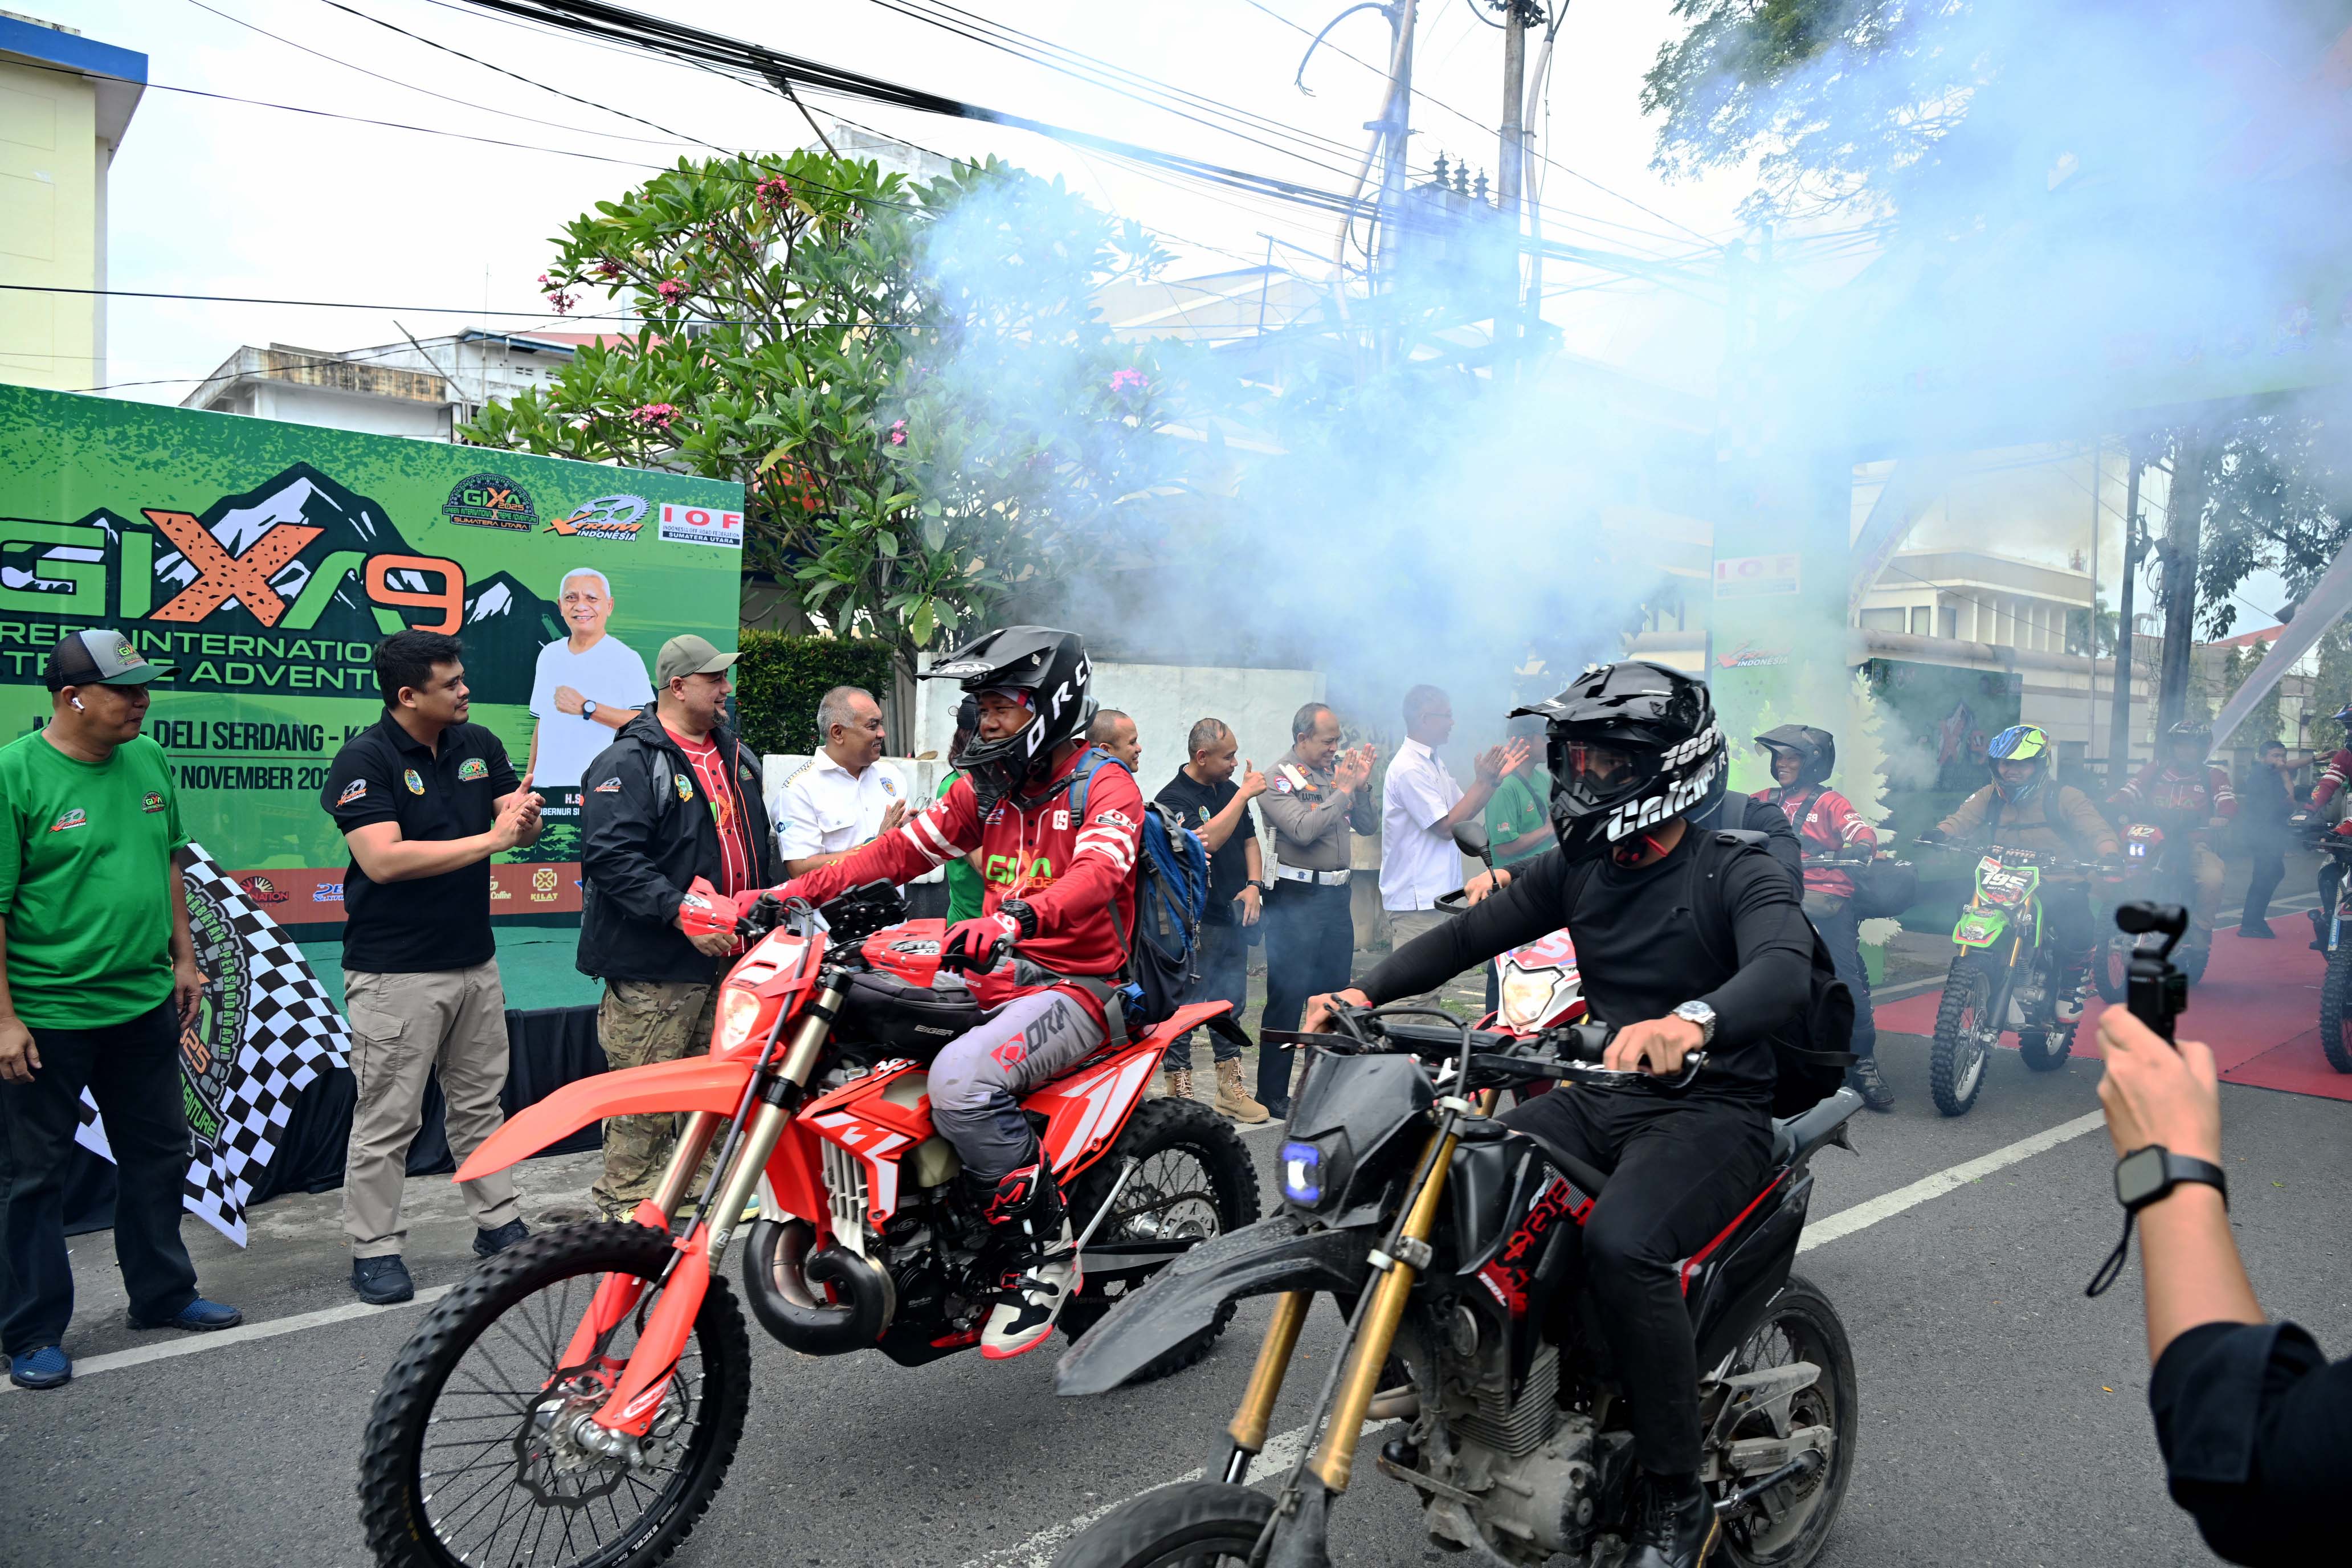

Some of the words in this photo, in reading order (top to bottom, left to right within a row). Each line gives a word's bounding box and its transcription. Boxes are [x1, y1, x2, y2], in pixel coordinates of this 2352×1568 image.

[463, 488, 521, 507] GIXA
[498, 502, 524, 511] 2025
[454, 517, 498, 526] SUMATERA
[577, 530, 636, 542] INDONESIA
[669, 532, 708, 541] SUMATERA
[1737, 656, 1788, 667] INDONESIA
[941, 665, 986, 674] Airoh
[153, 720, 207, 750] DELI
[213, 722, 324, 752] SERDANG
[181, 765, 292, 789] NOVEMBER
[2127, 827, 2155, 838] 142
[1981, 872, 2028, 888] 195
[491, 891, 511, 900] Coffee
[530, 893, 558, 901] KILAT
[896, 940, 940, 951] ZETA
[914, 1025, 954, 1036] EIGER
[631, 1524, 659, 1551] EXCEL
